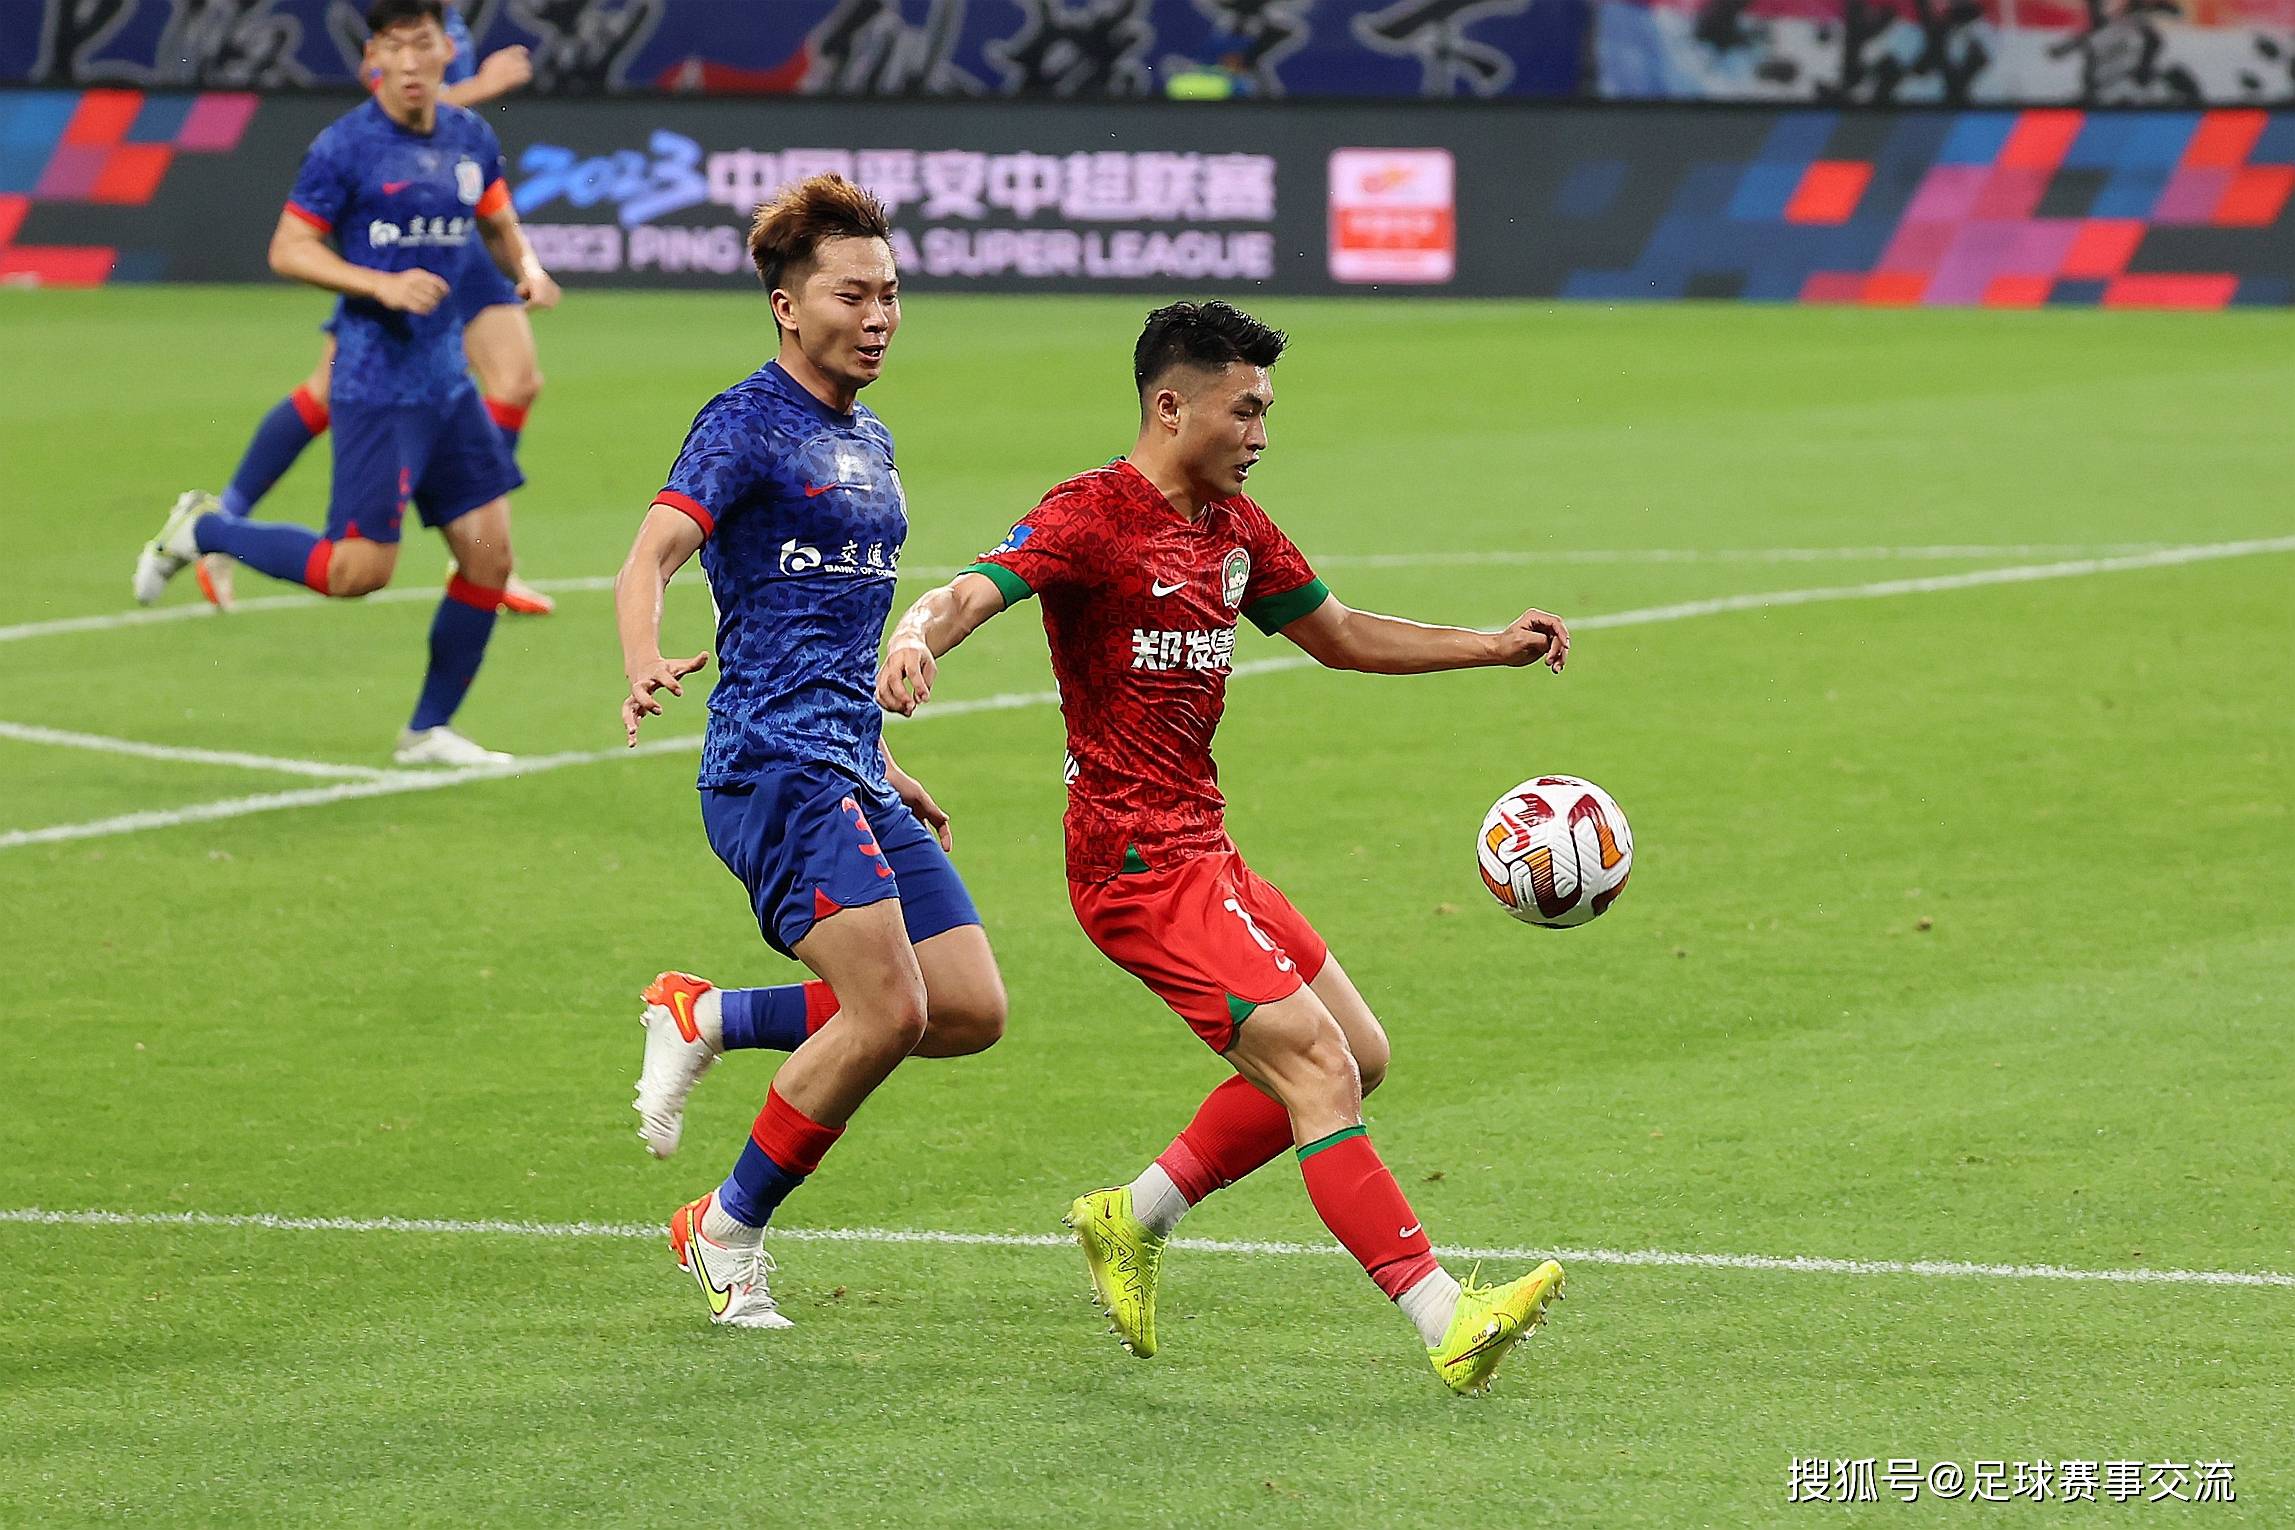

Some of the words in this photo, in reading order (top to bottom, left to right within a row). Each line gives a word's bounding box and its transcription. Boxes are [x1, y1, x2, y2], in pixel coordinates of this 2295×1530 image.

[513, 130, 708, 229] 2023
[628, 225, 742, 274] PING
[921, 227, 1080, 277] SUPER
[1083, 230, 1275, 278] LEAGUE
[1471, 1329, 1488, 1344] GAO
